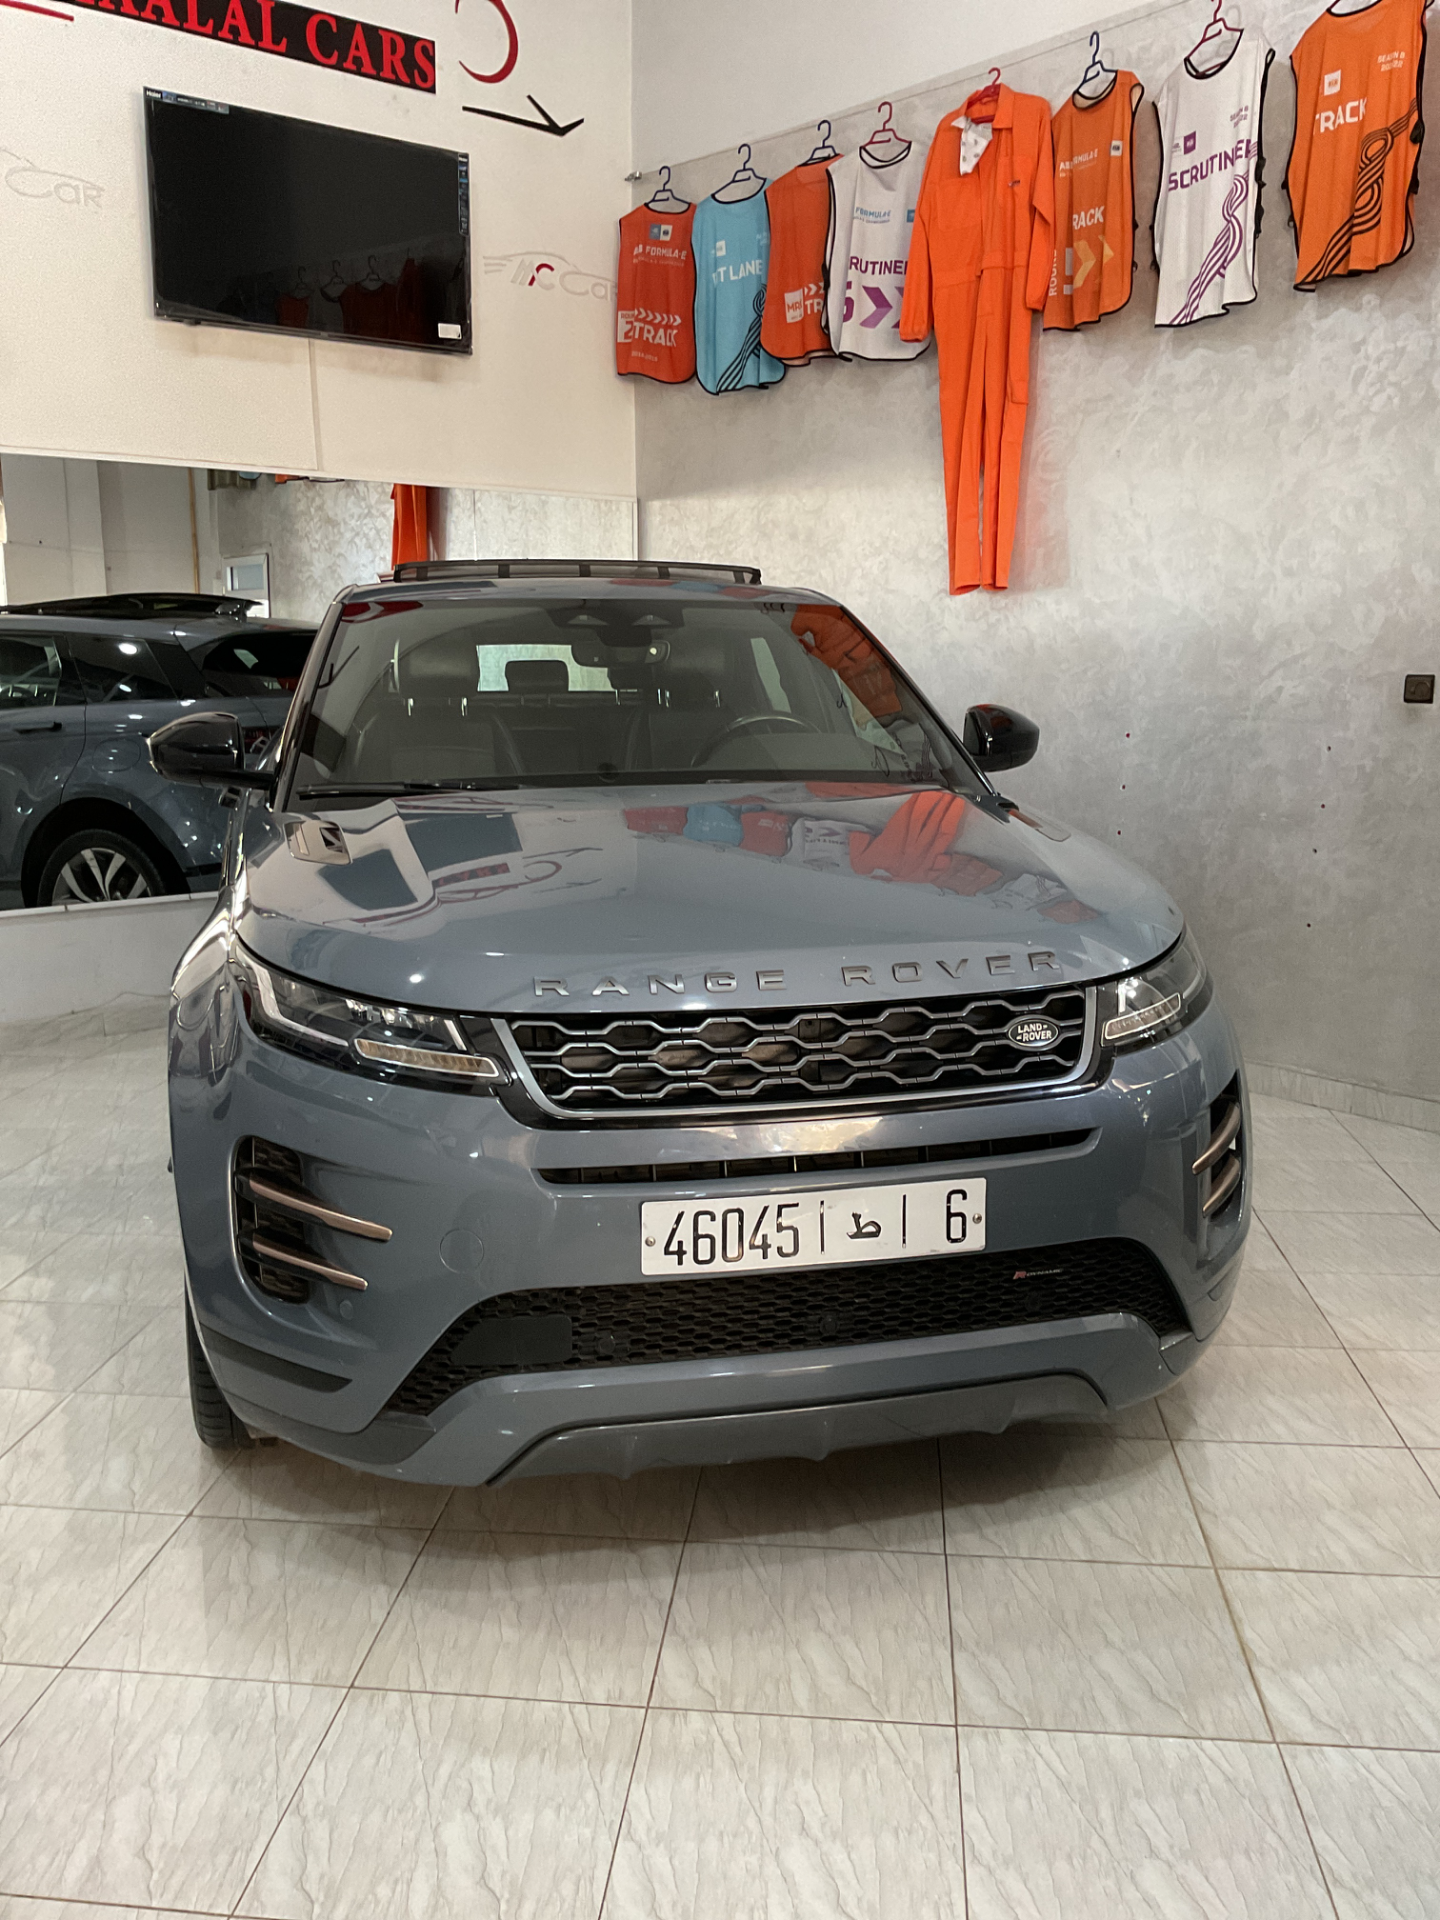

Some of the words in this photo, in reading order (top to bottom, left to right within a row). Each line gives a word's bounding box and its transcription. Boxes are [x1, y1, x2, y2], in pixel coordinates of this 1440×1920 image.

[305, 12, 435, 89] CARS
[730, 259, 763, 281] LANE
[533, 969, 787, 997] RANGE
[840, 951, 1060, 987] ROVER
[664, 1202, 800, 1266] 46045
[846, 1211, 882, 1240] ط
[945, 1188, 968, 1244] 6
